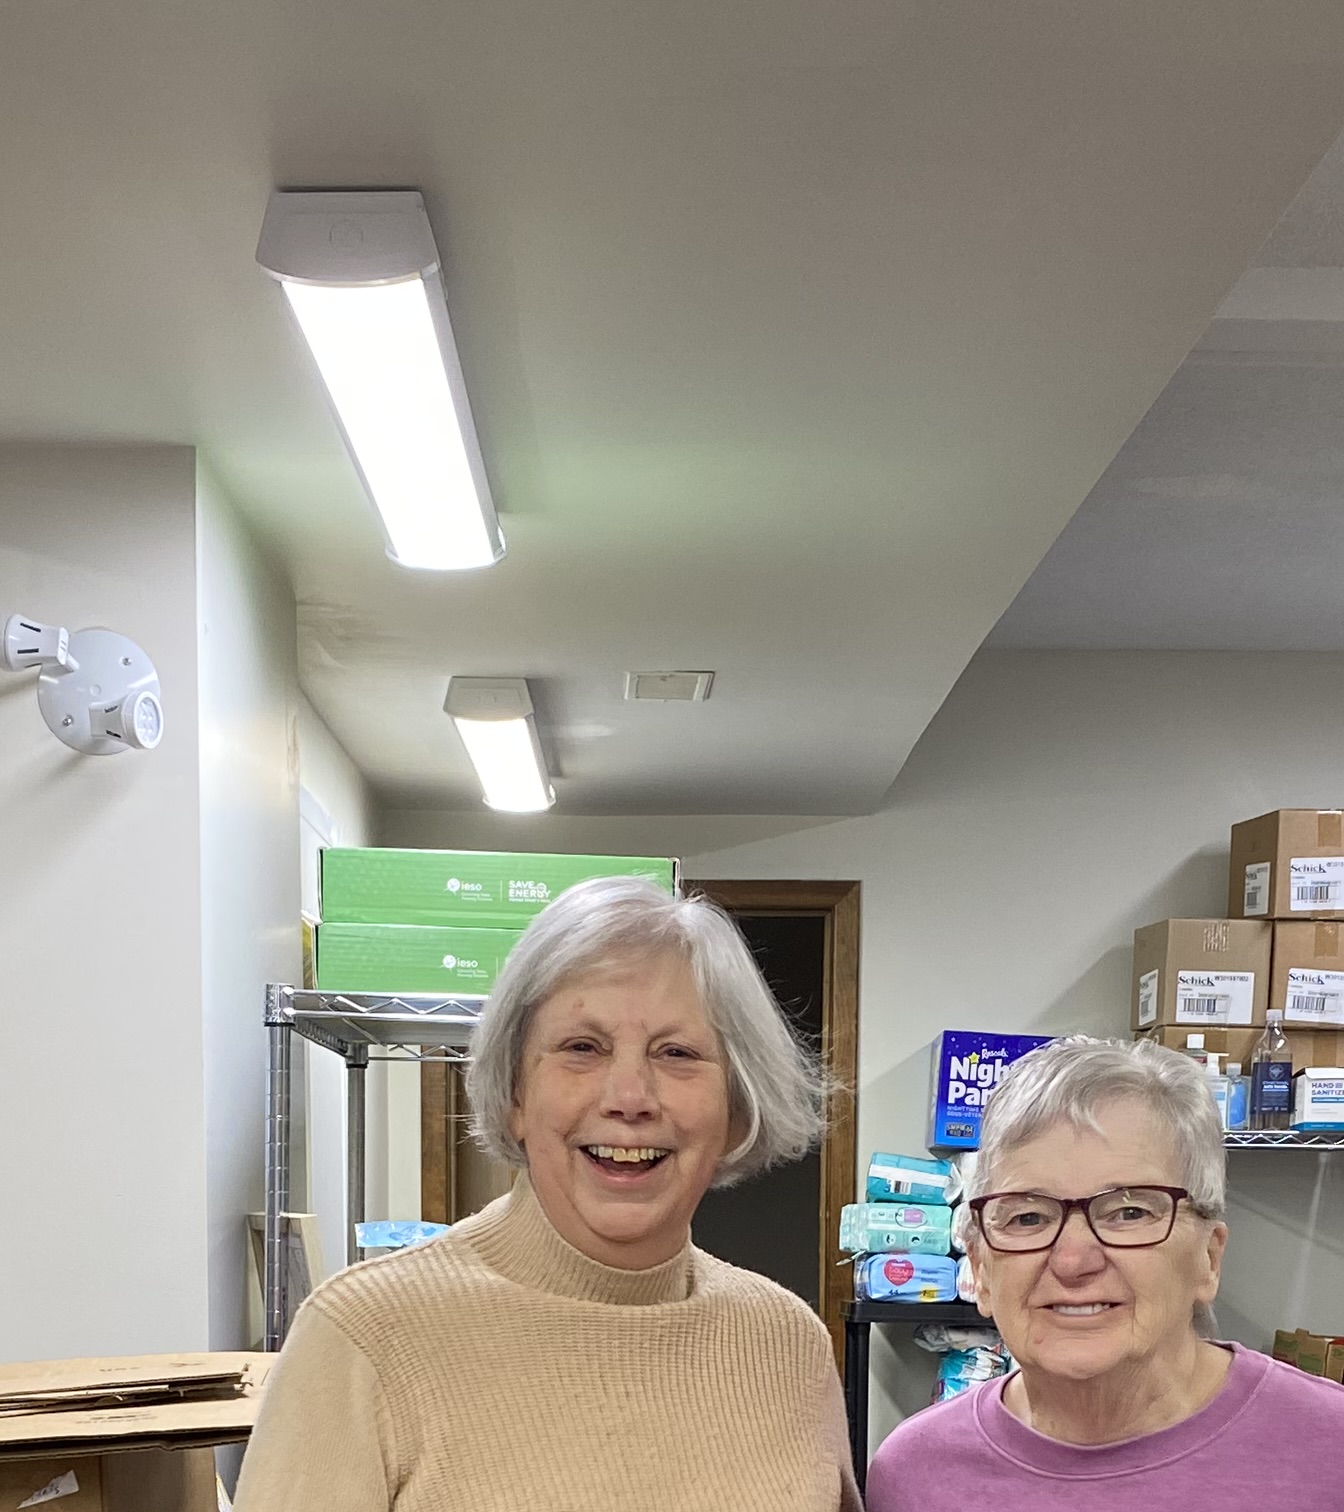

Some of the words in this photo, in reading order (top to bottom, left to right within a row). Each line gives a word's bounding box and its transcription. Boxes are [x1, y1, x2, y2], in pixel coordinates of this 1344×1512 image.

[1290, 863, 1327, 873] Schick
[461, 880, 482, 891] ieso
[508, 880, 535, 889] SAVE
[508, 888, 552, 898] ENERGY
[457, 957, 479, 968] ieso
[1178, 975, 1215, 986] Schick
[1288, 972, 1325, 985] Schick
[949, 1056, 1009, 1087] Nigh
